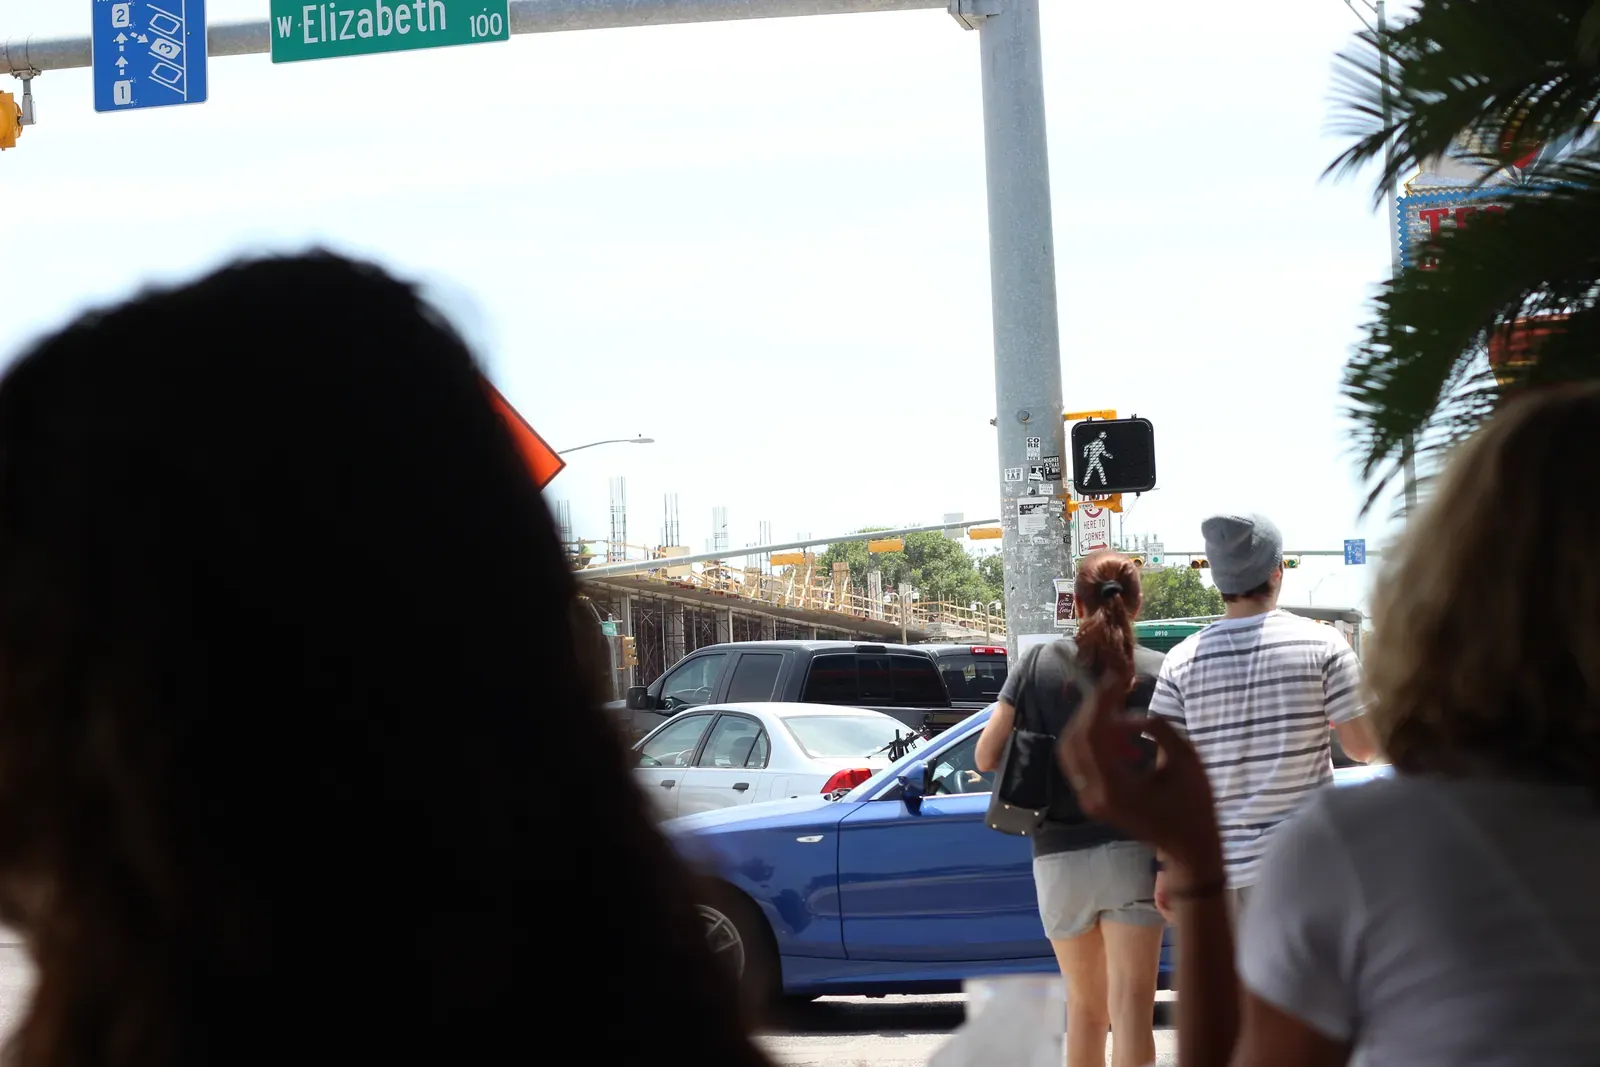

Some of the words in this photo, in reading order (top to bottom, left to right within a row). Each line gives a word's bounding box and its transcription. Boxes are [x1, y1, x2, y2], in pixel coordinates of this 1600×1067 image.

[116, 9, 125, 22] 2
[277, 16, 292, 38] W
[302, 0, 446, 44] Elizabeth
[469, 13, 503, 37] 100
[159, 43, 173, 54] 3
[120, 86, 125, 99] 1
[1083, 520, 1097, 529] HERE
[1099, 518, 1106, 528] TO
[1084, 531, 1105, 541] CORNER
